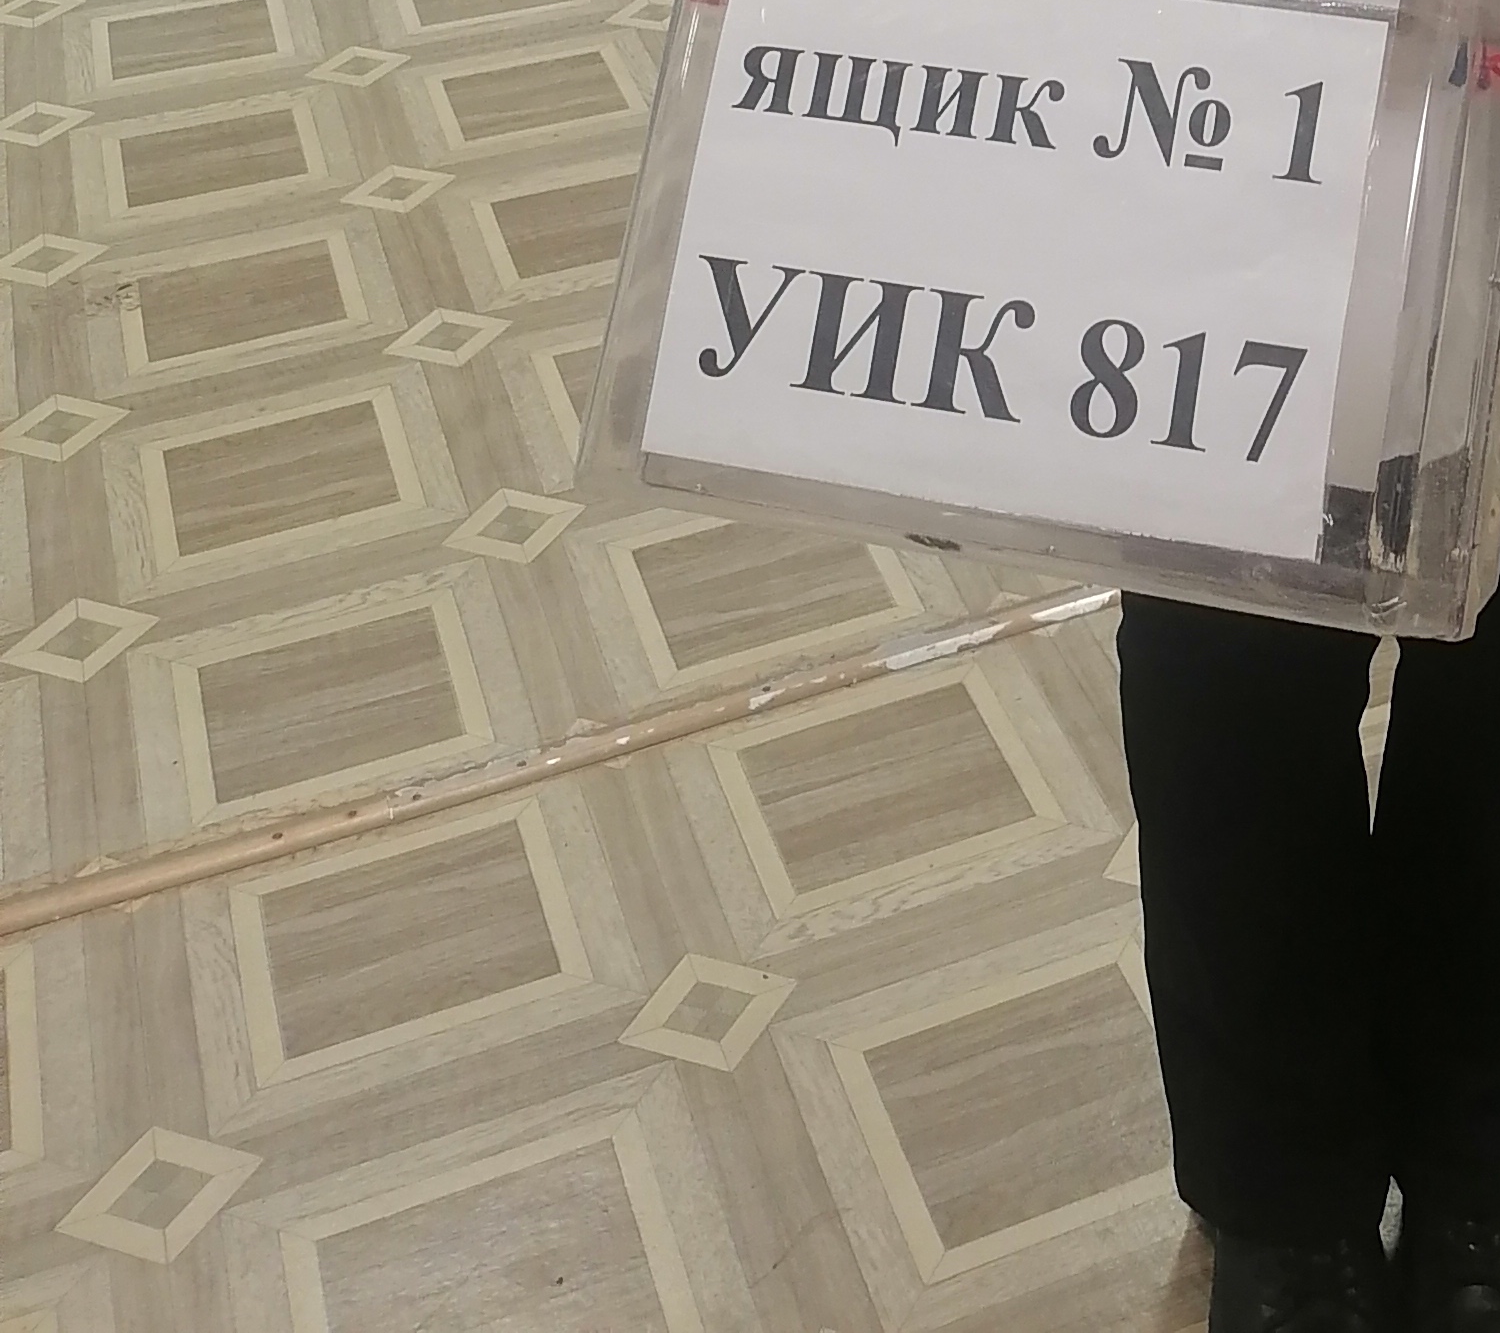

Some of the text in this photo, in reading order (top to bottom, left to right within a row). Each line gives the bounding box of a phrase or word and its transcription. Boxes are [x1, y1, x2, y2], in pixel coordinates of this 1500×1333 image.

[730, 43, 1327, 184] ящик № 1
[697, 253, 1309, 463] УИК 817
